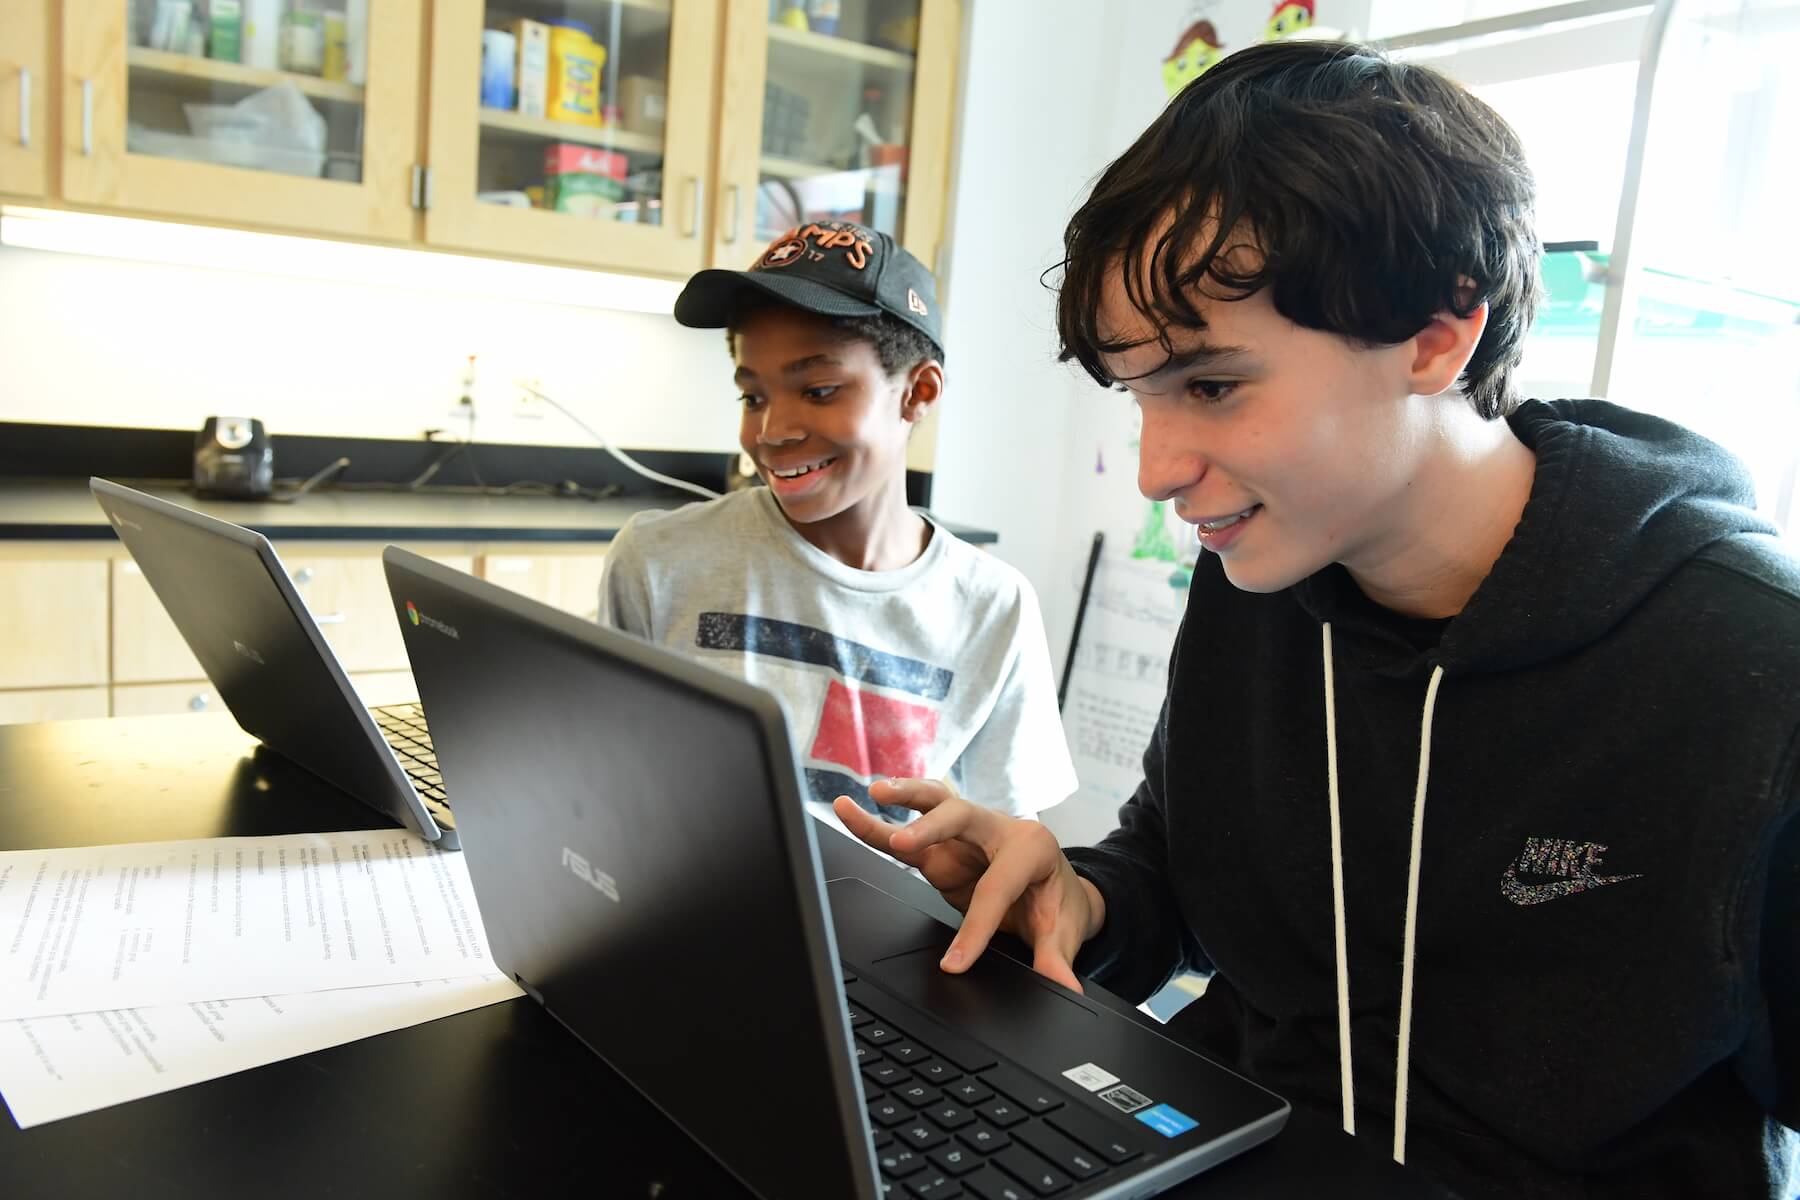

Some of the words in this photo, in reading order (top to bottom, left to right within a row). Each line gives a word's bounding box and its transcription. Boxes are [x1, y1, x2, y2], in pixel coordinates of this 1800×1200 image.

[806, 249, 825, 262] 17
[1519, 837, 1608, 879] NIKE
[562, 847, 620, 903] ASUS
[909, 1087, 923, 1096] d
[963, 1086, 975, 1094] x
